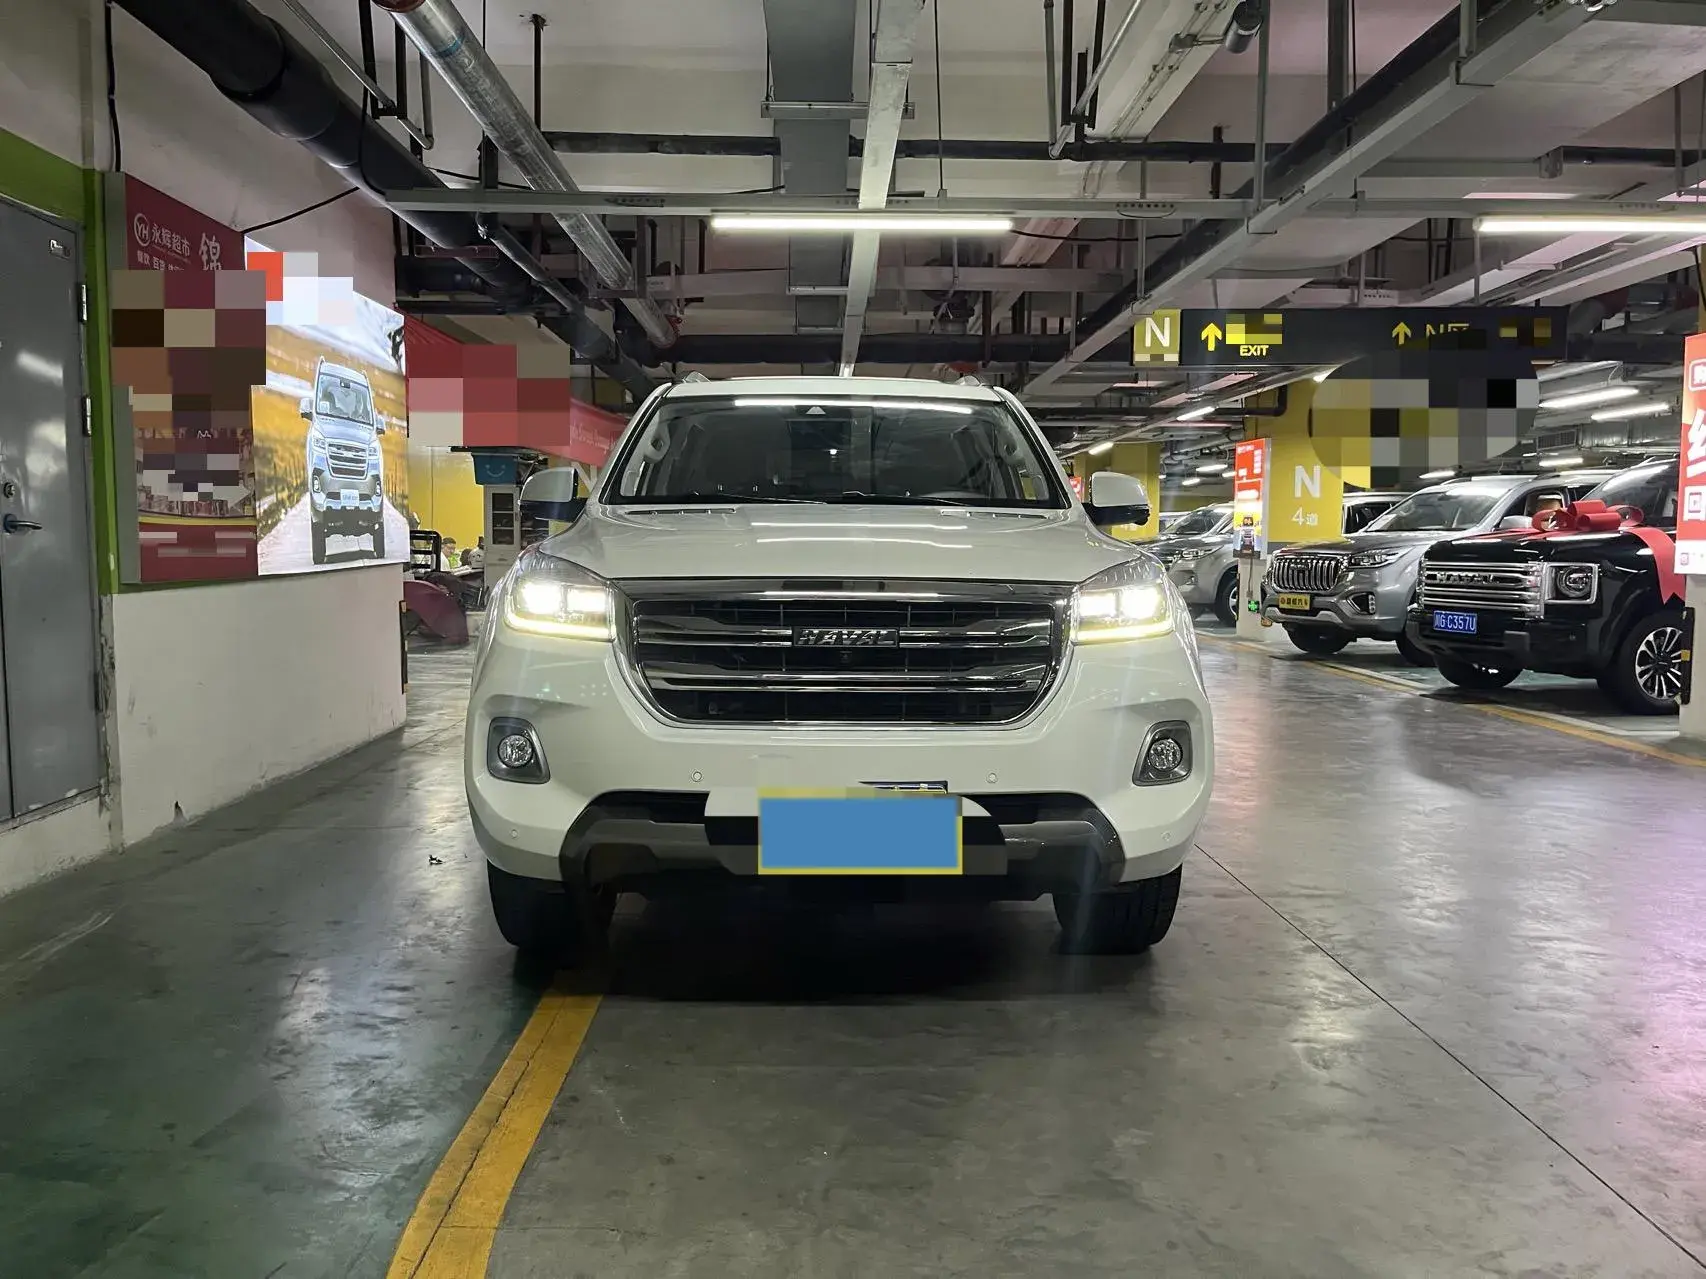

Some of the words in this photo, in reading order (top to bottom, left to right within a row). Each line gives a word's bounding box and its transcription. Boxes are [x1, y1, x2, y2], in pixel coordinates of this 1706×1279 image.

[151, 223, 191, 257] 永辉超市
[1144, 316, 1171, 348] N
[1239, 344, 1269, 357] EXIT
[1294, 465, 1320, 498] N
[797, 629, 895, 645] HAVAL
